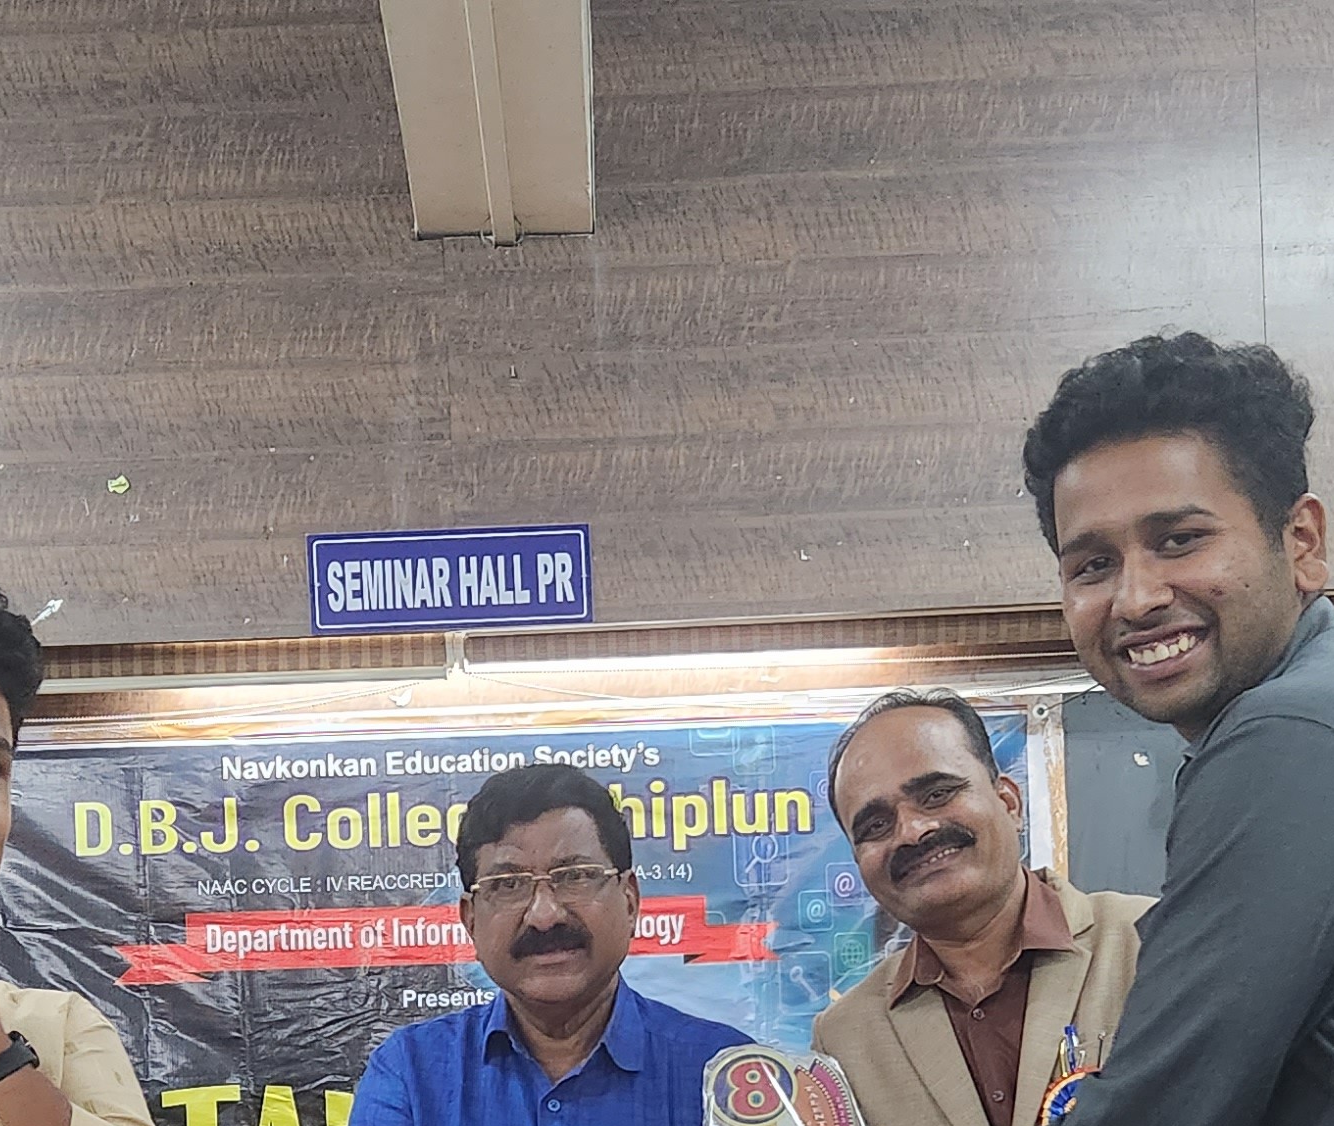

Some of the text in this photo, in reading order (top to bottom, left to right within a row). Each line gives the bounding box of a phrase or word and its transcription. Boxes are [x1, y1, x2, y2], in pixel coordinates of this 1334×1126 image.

[327, 552, 575, 612] SEMINAR HALL PR
[221, 741, 660, 780] Navkonkan Education Society's
[75, 779, 813, 857] D.B.J. Colle hiplun
[198, 879, 248, 896] NAAC
[252, 876, 312, 895] CYCLE
[326, 876, 343, 892] IV
[348, 872, 460, 891] REACCREDIT
[635, 863, 693, 882] A-3.14)
[206, 922, 354, 959] Department
[360, 918, 385, 948] of
[634, 912, 685, 945] logy
[402, 988, 495, 1008] Presents
